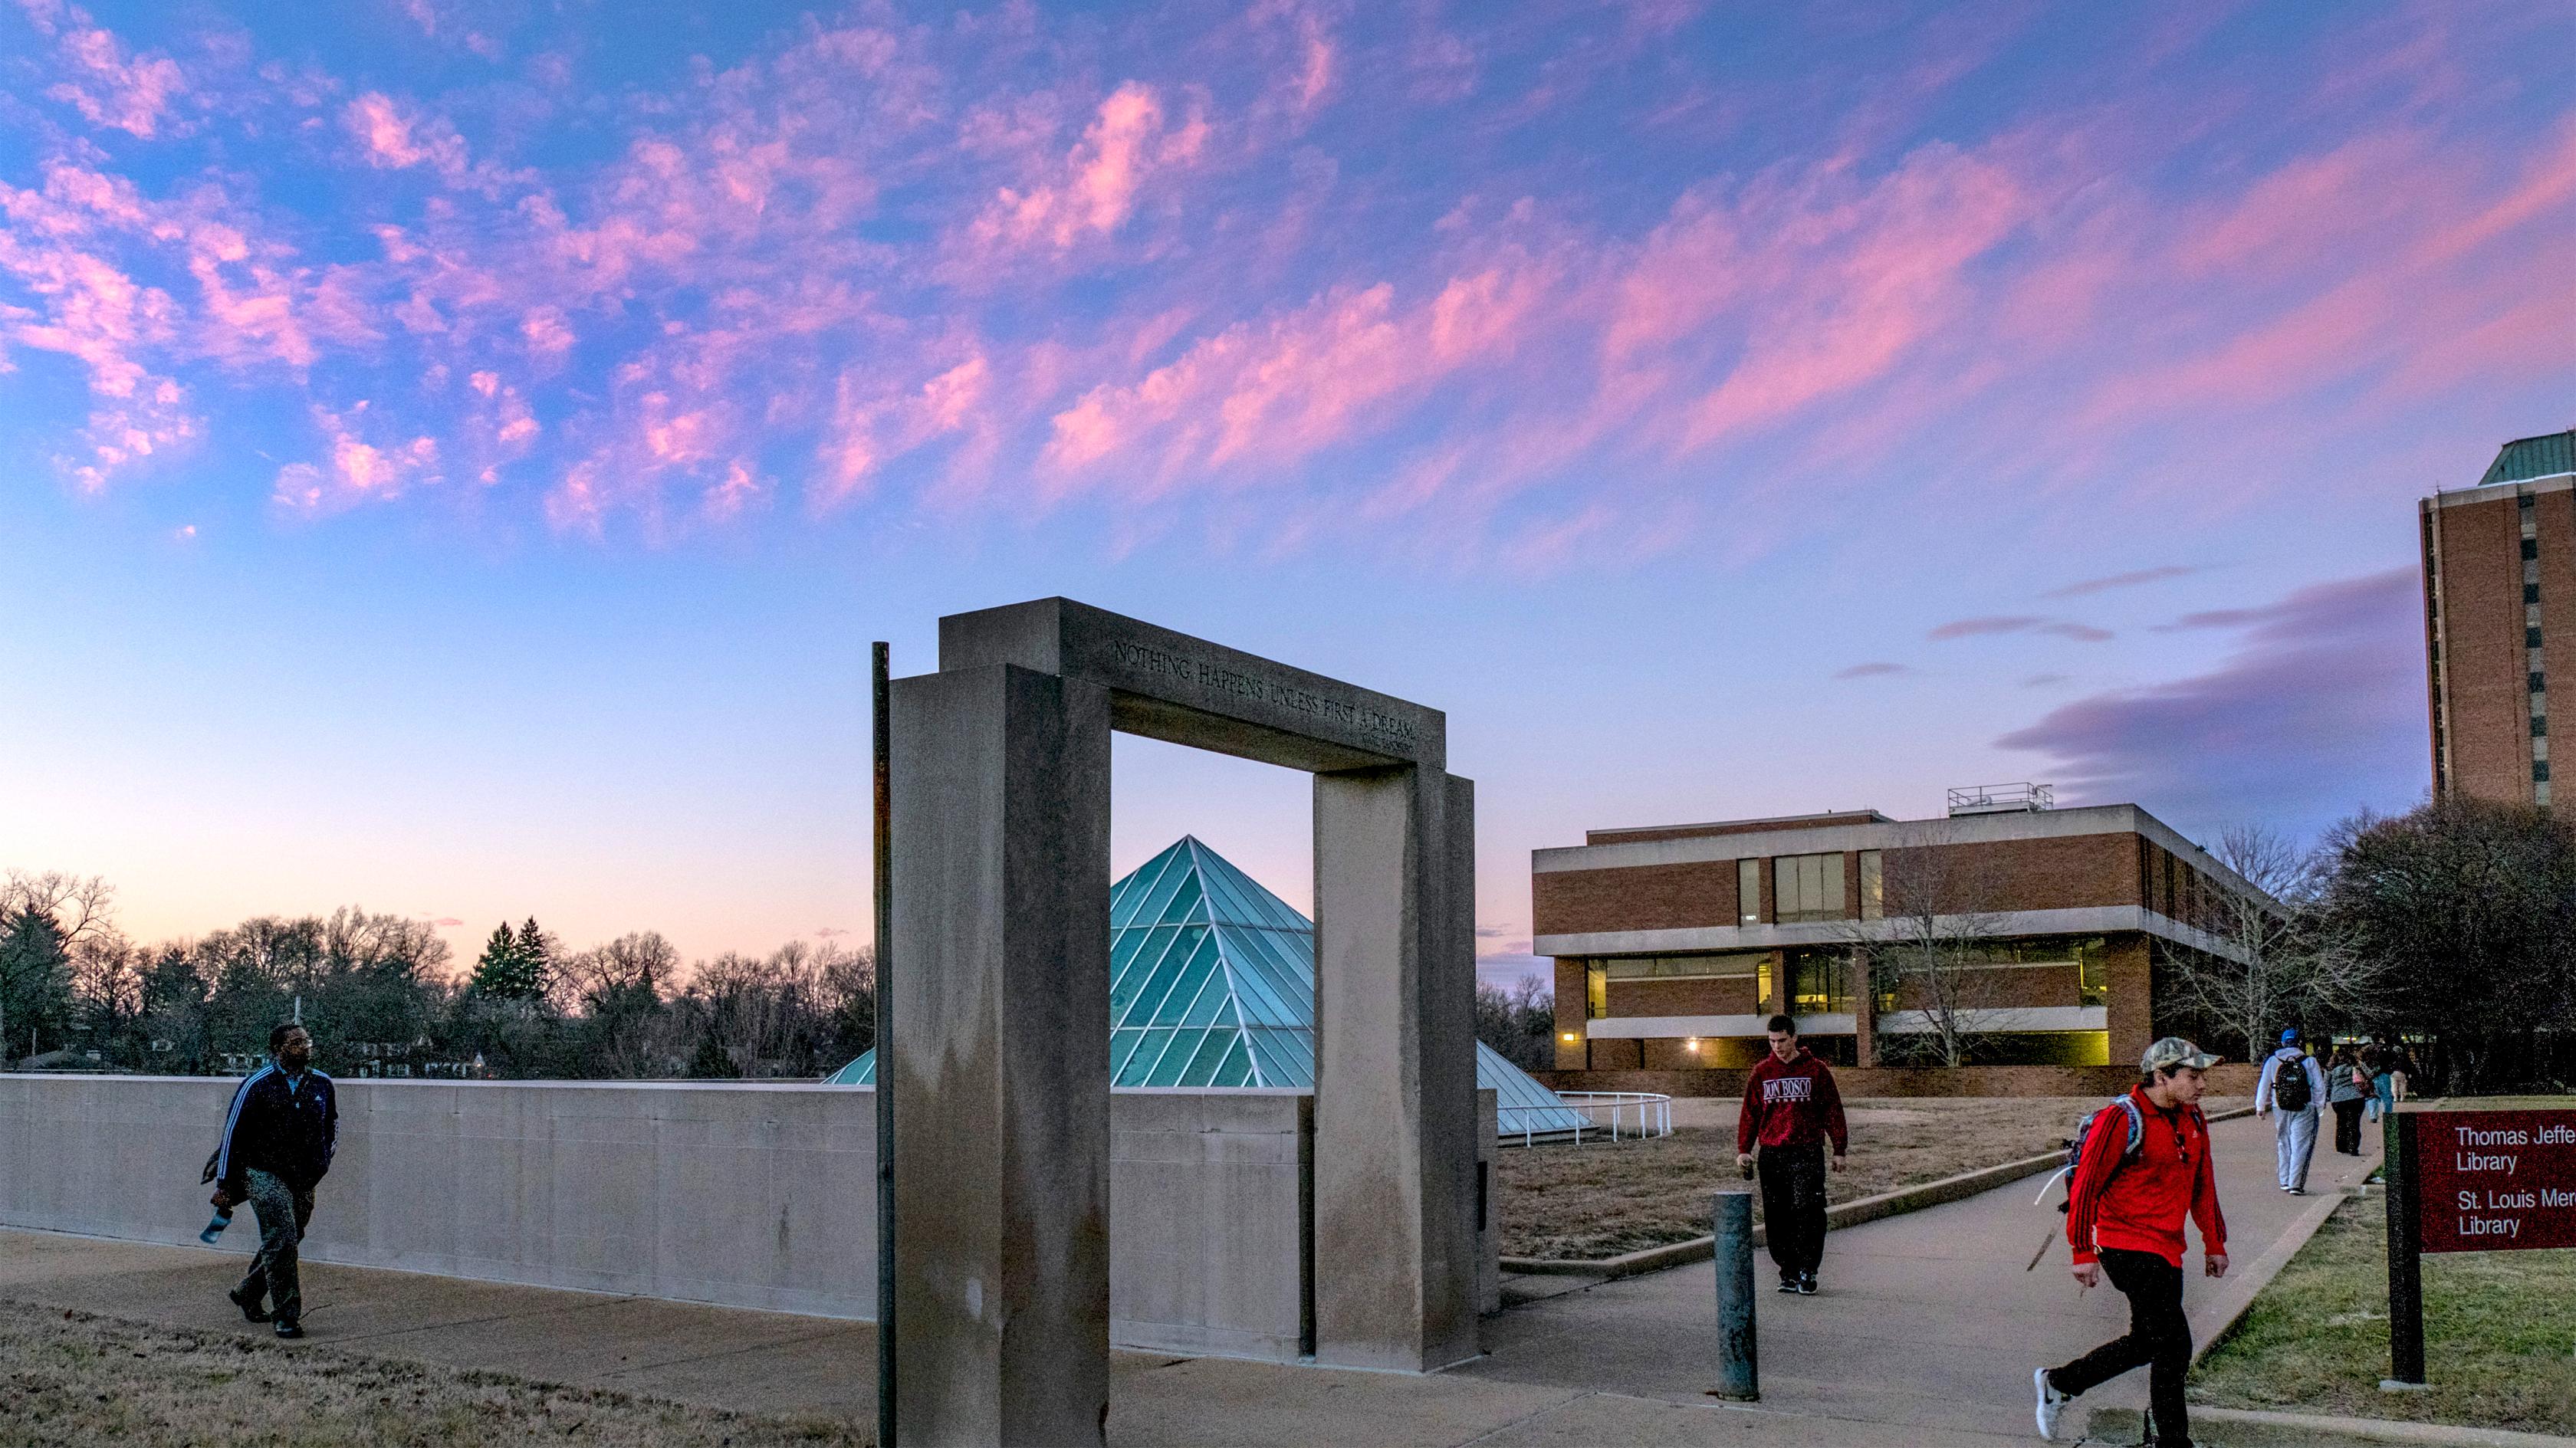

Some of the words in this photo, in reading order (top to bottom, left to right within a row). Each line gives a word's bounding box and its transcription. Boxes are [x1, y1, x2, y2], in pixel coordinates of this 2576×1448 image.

[1114, 640, 1190, 679] NOTHING
[1198, 663, 1263, 699] HAPPENS
[1271, 684, 1319, 714] UNLESS
[1324, 698, 1355, 724] FIRST
[1359, 711, 1368, 728] A
[1763, 1082, 1779, 1098] DON
[1782, 1079, 1811, 1095] BOSCO
[2455, 1127, 2528, 1145] Thomas
[2533, 1125, 2576, 1144] Jeffe
[2456, 1151, 2517, 1174] Library
[2458, 1190, 2482, 1210] St.
[2489, 1189, 2535, 1209] Louis
[2541, 1188, 2576, 1207] Mer
[2459, 1216, 2520, 1238] Library
